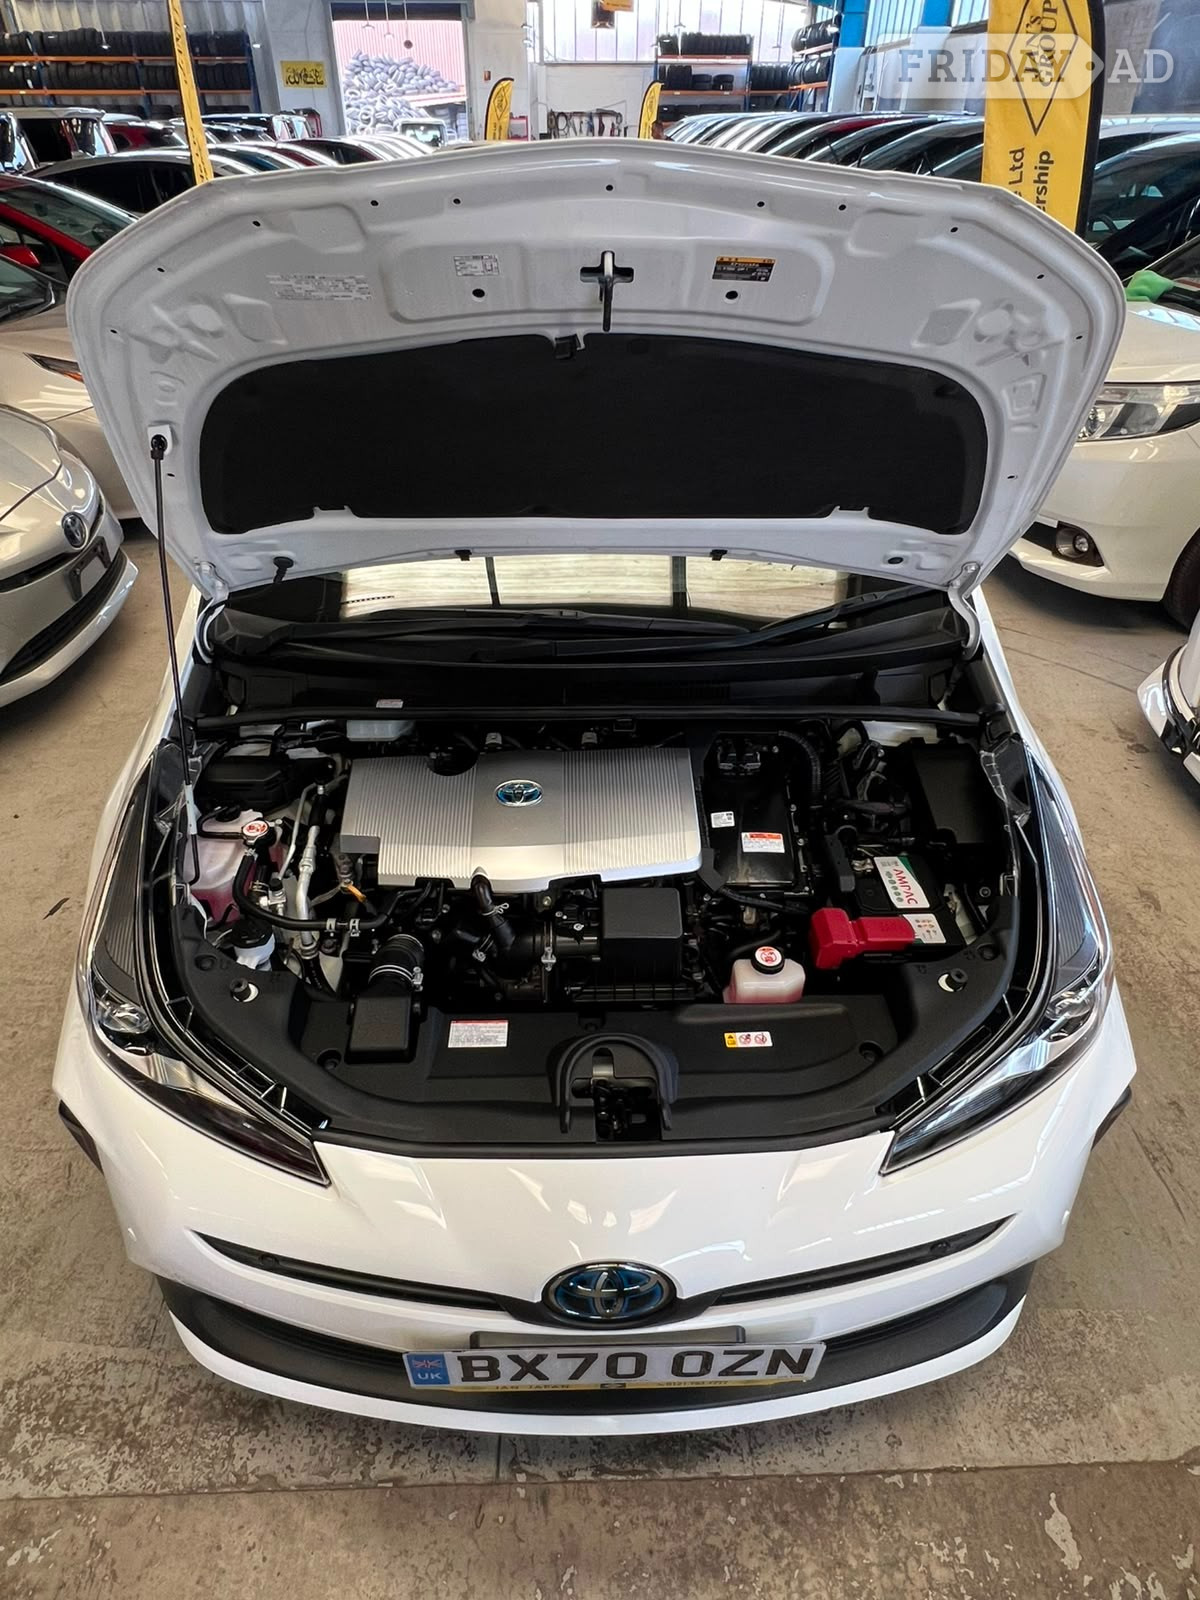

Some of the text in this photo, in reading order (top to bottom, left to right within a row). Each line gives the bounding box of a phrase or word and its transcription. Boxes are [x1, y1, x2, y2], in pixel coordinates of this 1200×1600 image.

[1039, 0, 1059, 87] GROUP
[1008, 147, 1025, 185] Ltd
[417, 1372, 442, 1380] UK
[457, 1347, 815, 1382] BX70 OZN
